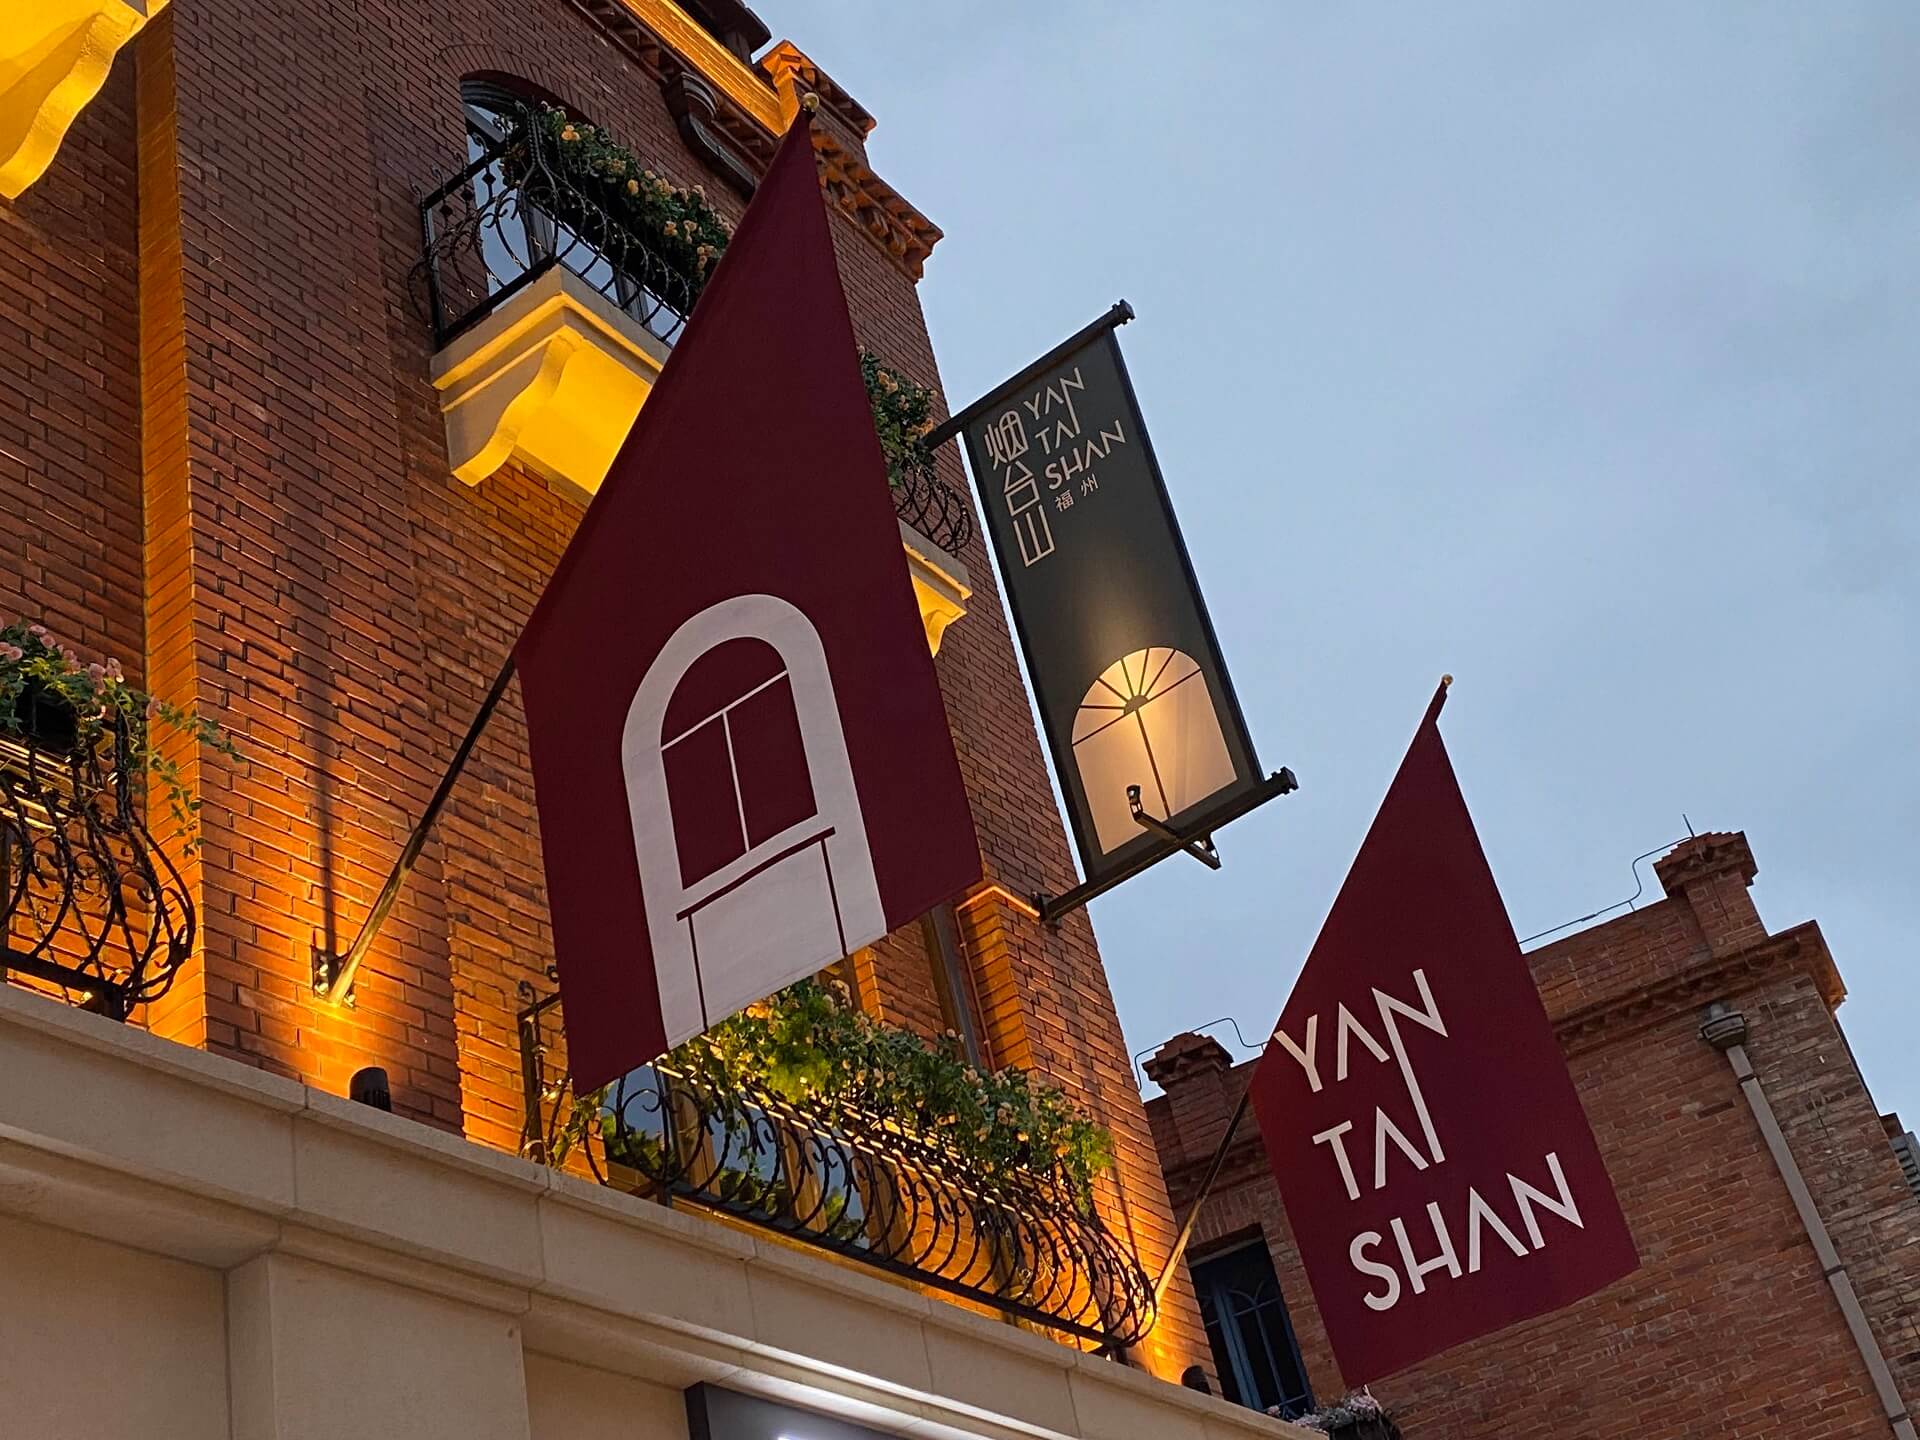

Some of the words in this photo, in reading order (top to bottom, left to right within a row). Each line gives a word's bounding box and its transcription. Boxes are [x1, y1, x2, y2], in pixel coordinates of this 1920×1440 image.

[1023, 367, 1085, 421] YAN
[1045, 419, 1127, 490] SHAN
[1273, 968, 1448, 1105] YAN
[1349, 1151, 1584, 1311] SHAN
